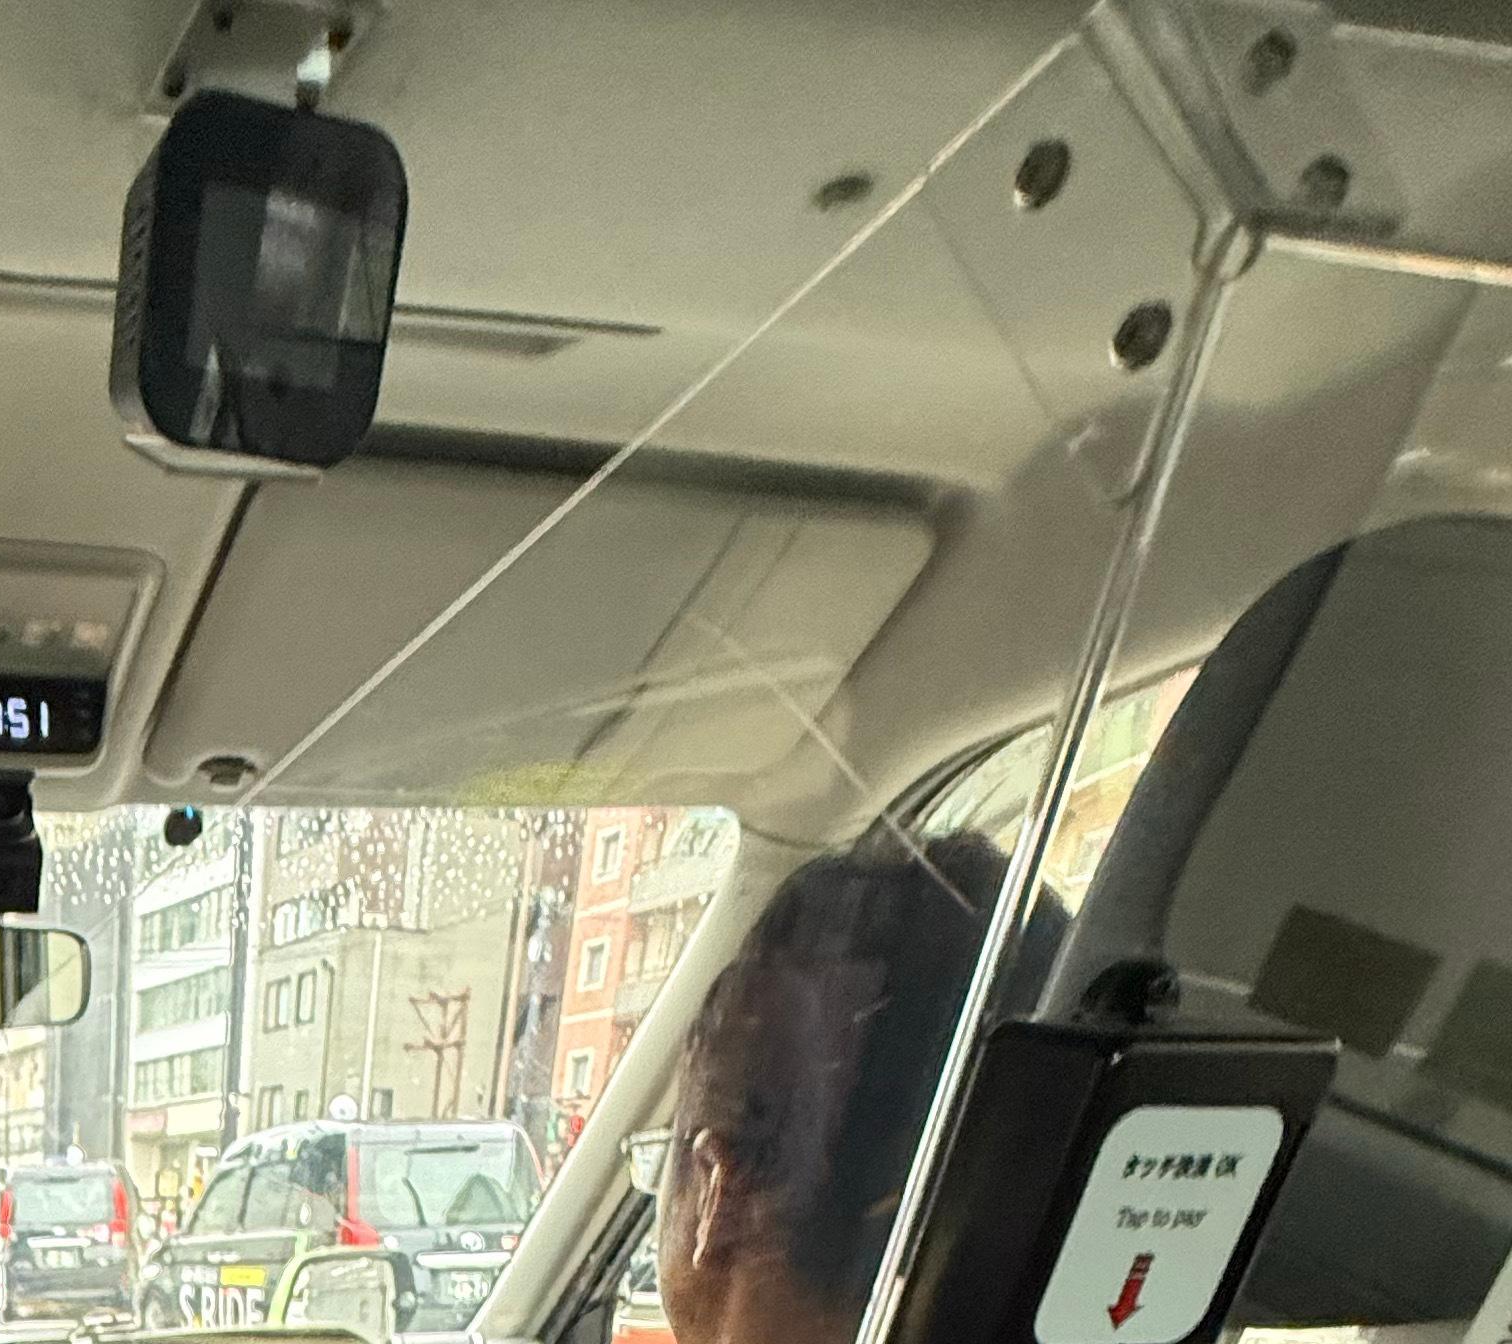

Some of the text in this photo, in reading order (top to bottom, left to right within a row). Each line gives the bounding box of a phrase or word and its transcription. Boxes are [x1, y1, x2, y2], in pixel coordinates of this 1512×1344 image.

[1116, 1205, 1208, 1230] Tap to pay
